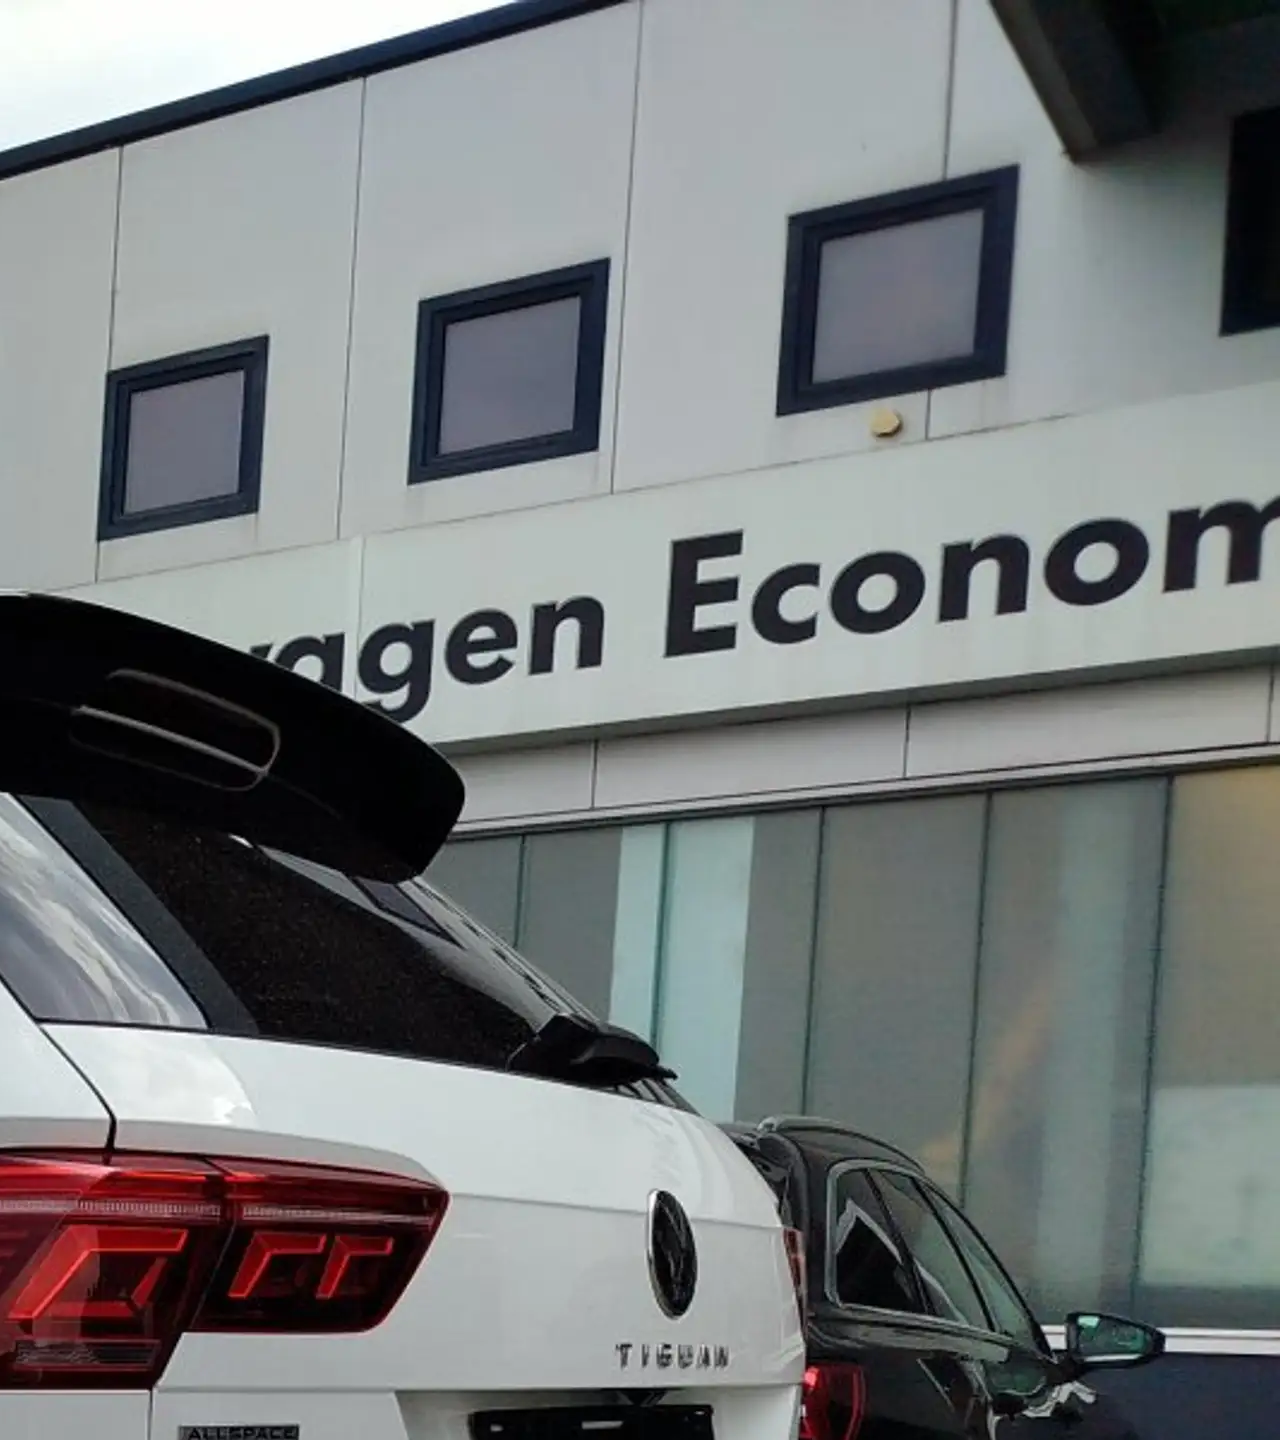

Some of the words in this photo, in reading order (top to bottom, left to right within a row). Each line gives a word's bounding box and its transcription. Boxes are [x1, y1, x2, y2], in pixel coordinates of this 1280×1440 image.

[248, 596, 604, 724] agen
[663, 497, 1280, 657] Econom
[614, 1343, 730, 1370] TIGUAN
